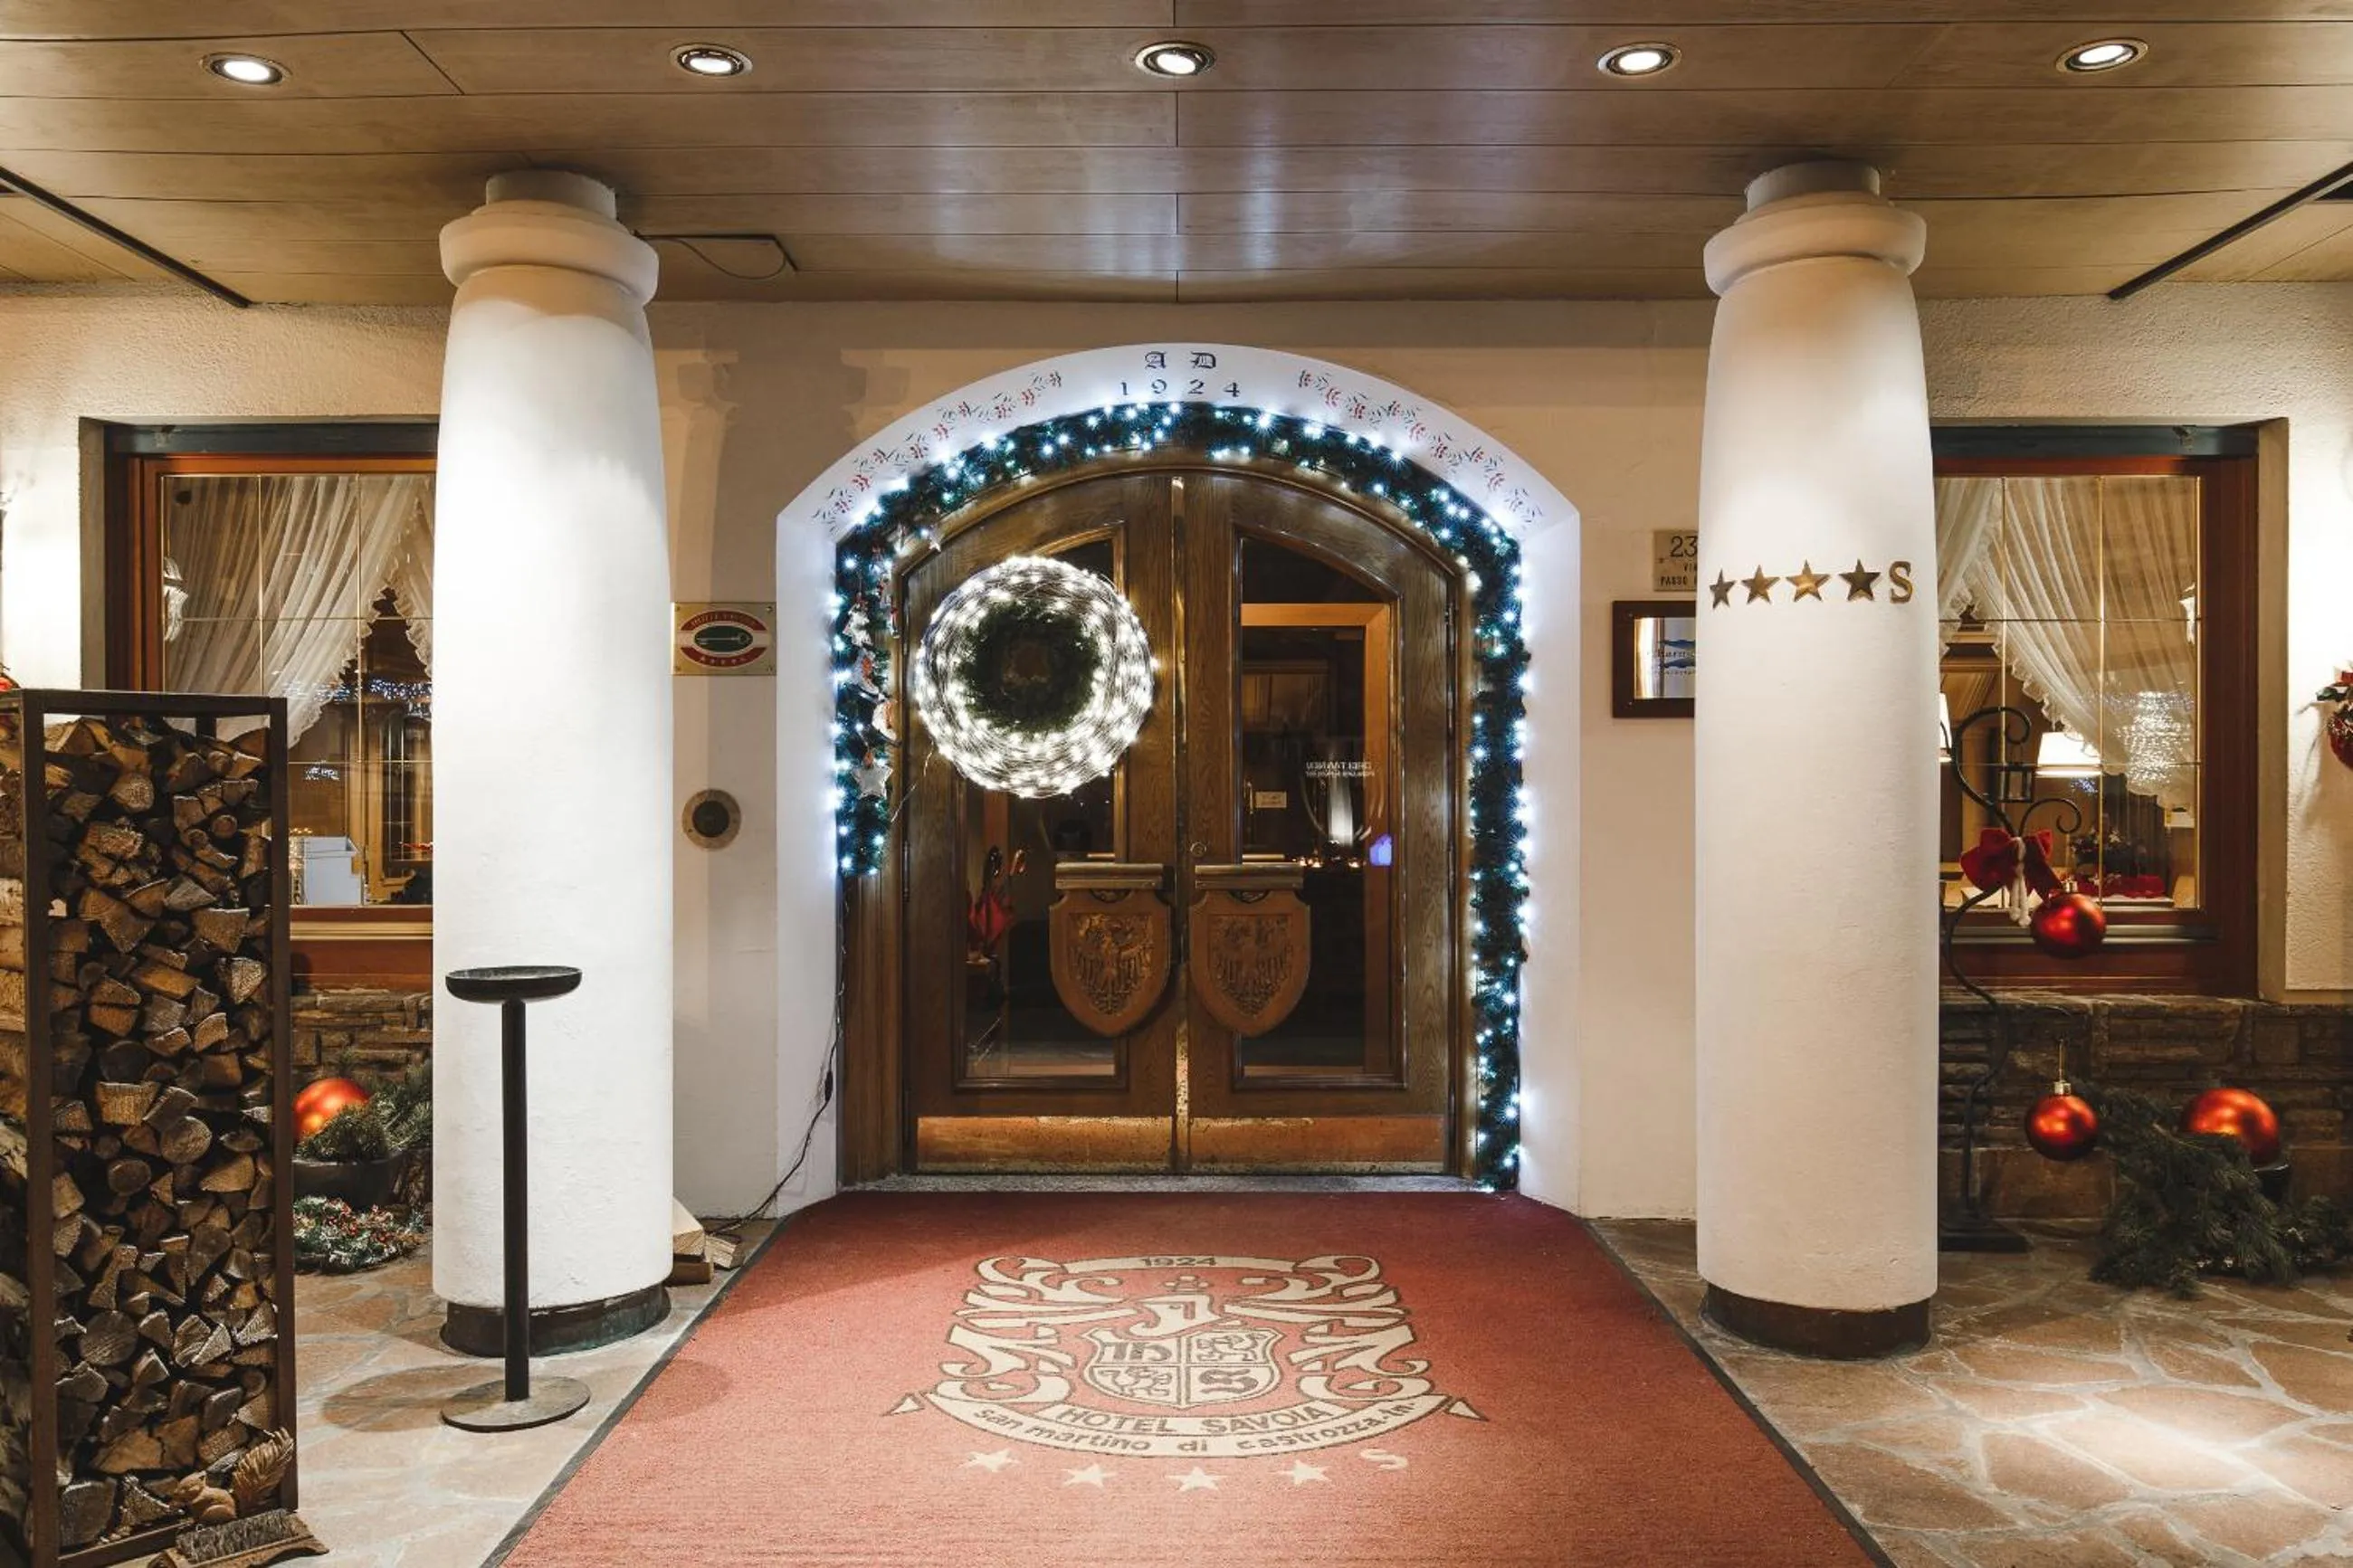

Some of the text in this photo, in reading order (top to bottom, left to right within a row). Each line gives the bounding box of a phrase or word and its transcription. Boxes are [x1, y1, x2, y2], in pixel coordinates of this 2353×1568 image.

[1889, 560, 1913, 604] S
[1141, 1256, 1216, 1266] 1924
[1055, 1408, 1176, 1433] HOTEL
[1201, 1405, 1333, 1433] SAVOIA
[1024, 1425, 1151, 1450] martino
[1176, 1440, 1208, 1452] di
[1359, 1449, 1408, 1470] S
